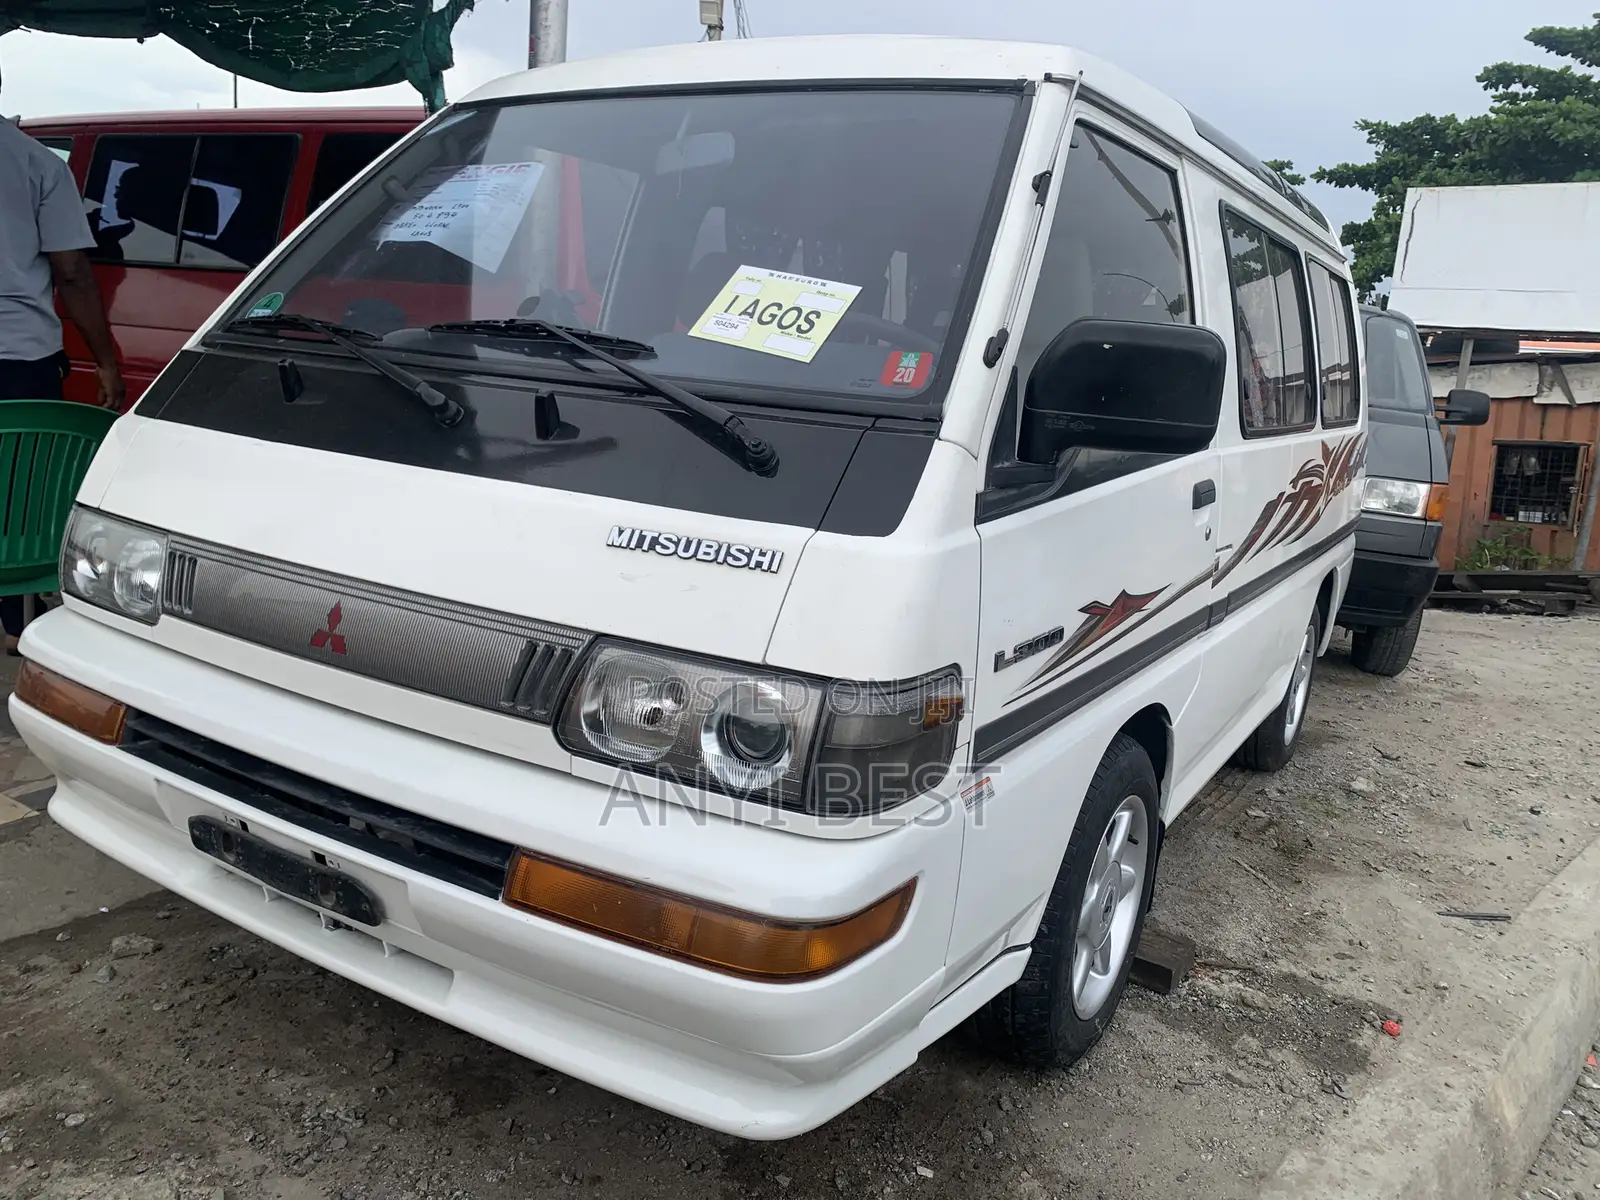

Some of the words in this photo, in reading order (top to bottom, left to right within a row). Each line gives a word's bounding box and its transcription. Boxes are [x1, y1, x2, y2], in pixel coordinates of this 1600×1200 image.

[893, 367, 916, 383] 20
[606, 525, 784, 574] MITSUBISHI
[993, 625, 1065, 673] L300
